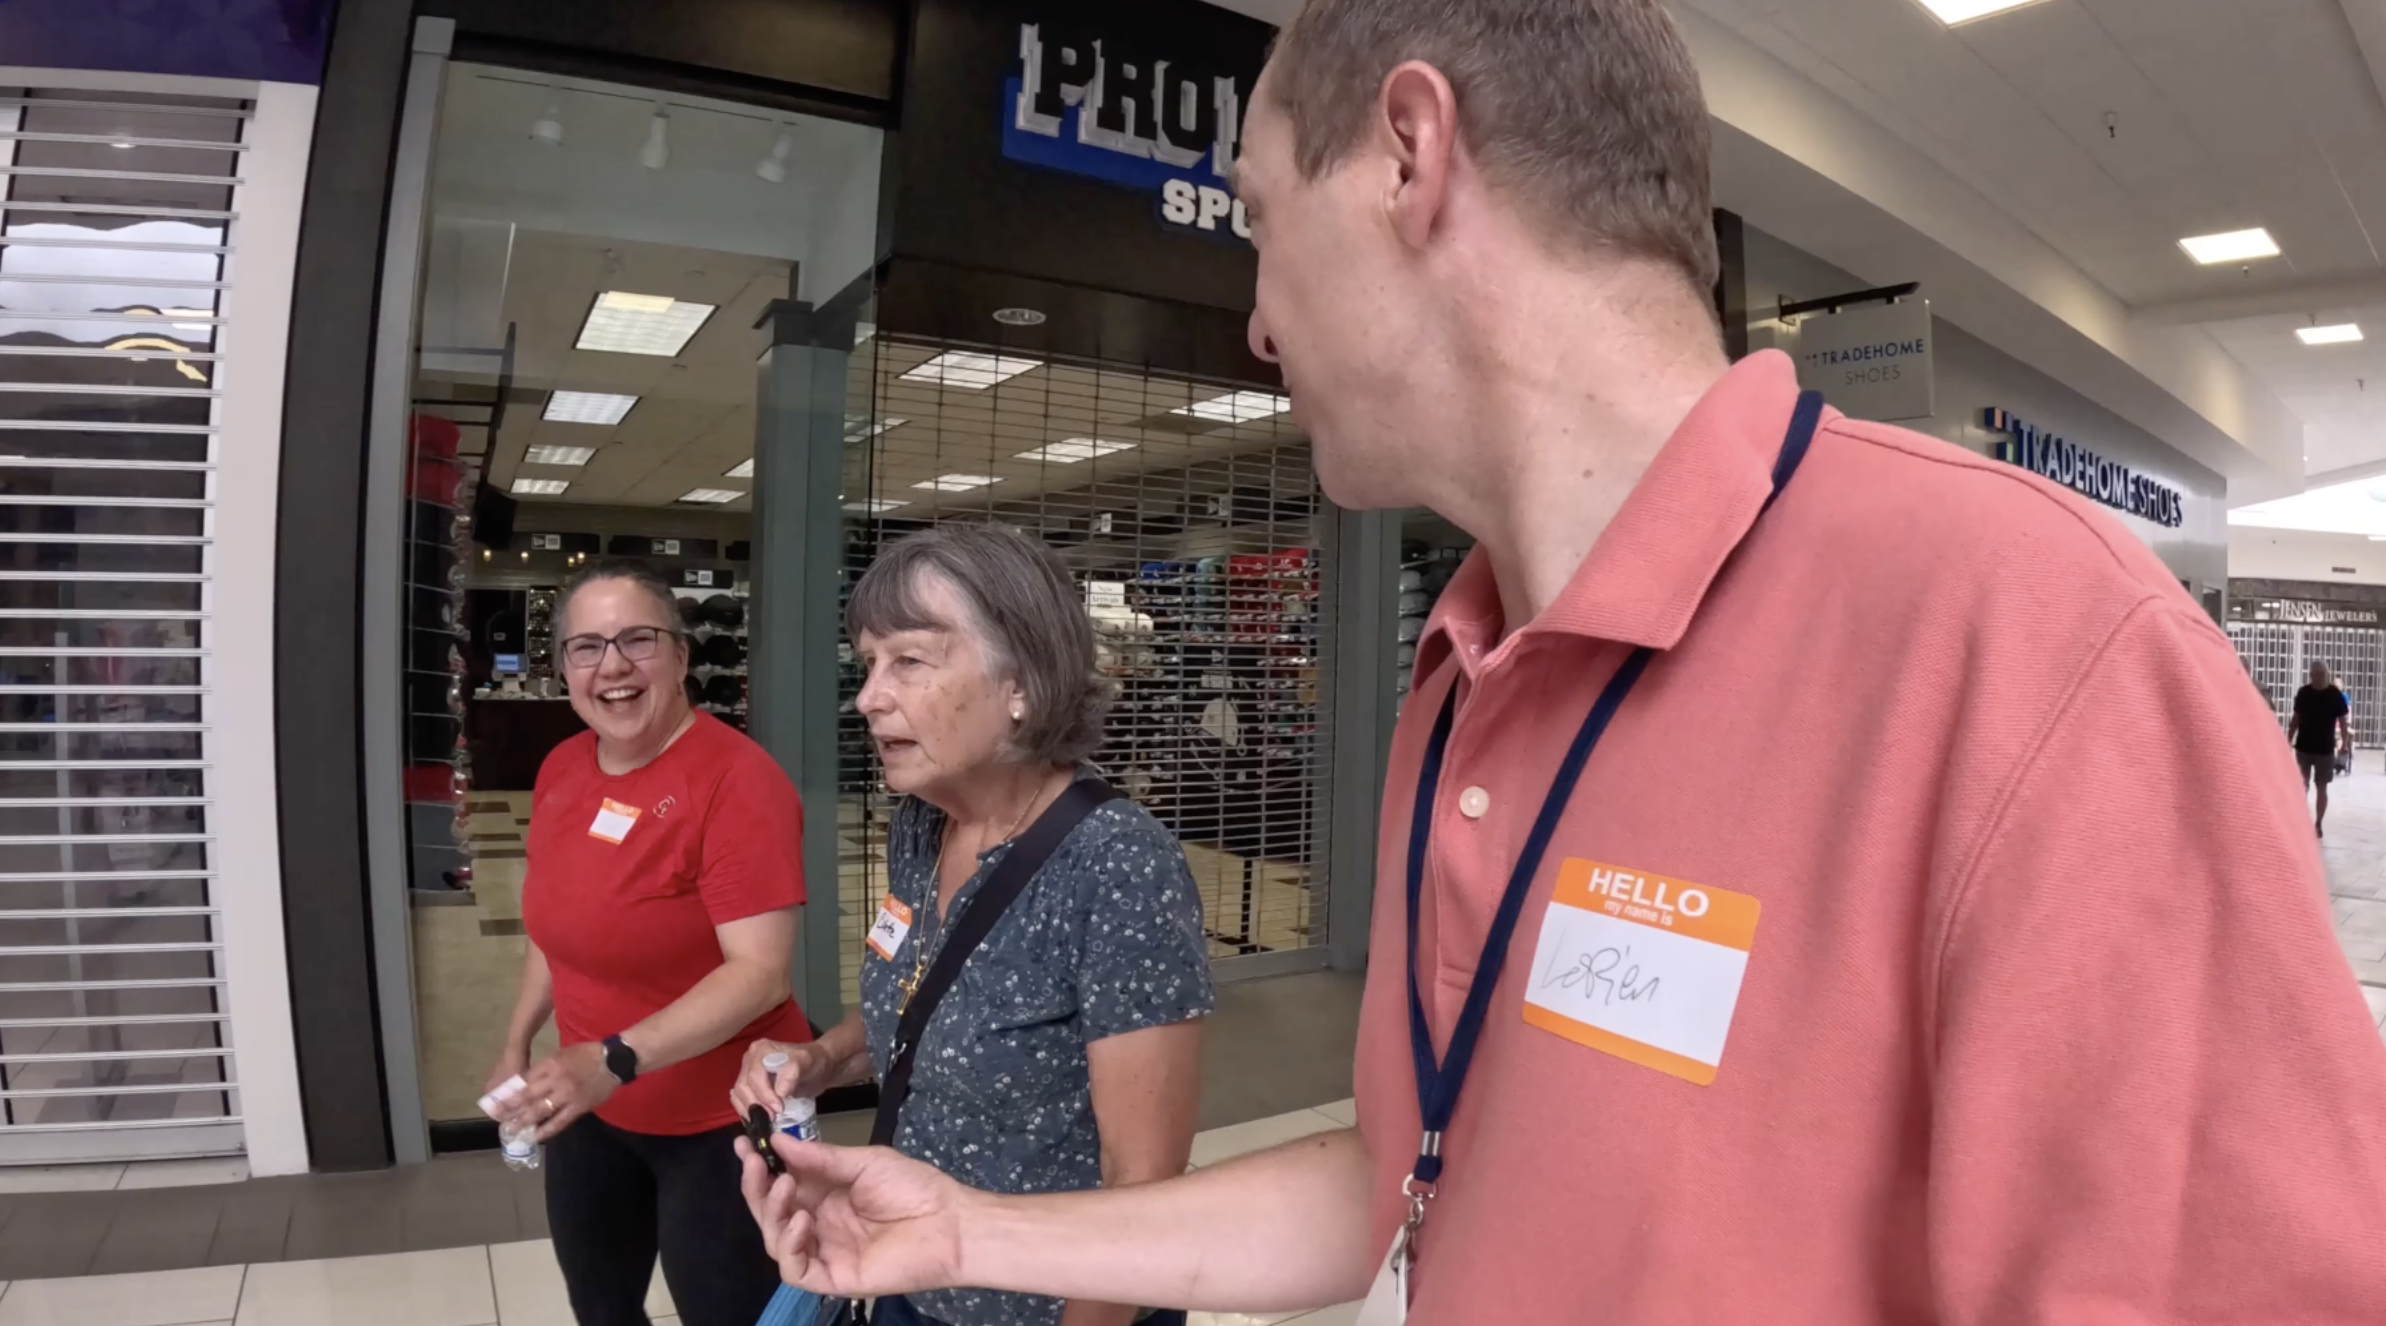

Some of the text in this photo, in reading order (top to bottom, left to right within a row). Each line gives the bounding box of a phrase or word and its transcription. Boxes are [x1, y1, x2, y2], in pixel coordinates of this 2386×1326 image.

[1822, 339, 1924, 365] TRADEHOME
[1845, 365, 1901, 385] SHOES
[2015, 418, 2182, 527] TRADEHOME SHOES
[2280, 599, 2322, 622] JENSEN
[1588, 868, 1709, 917] HELLO
[1604, 900, 1674, 926] my name is
